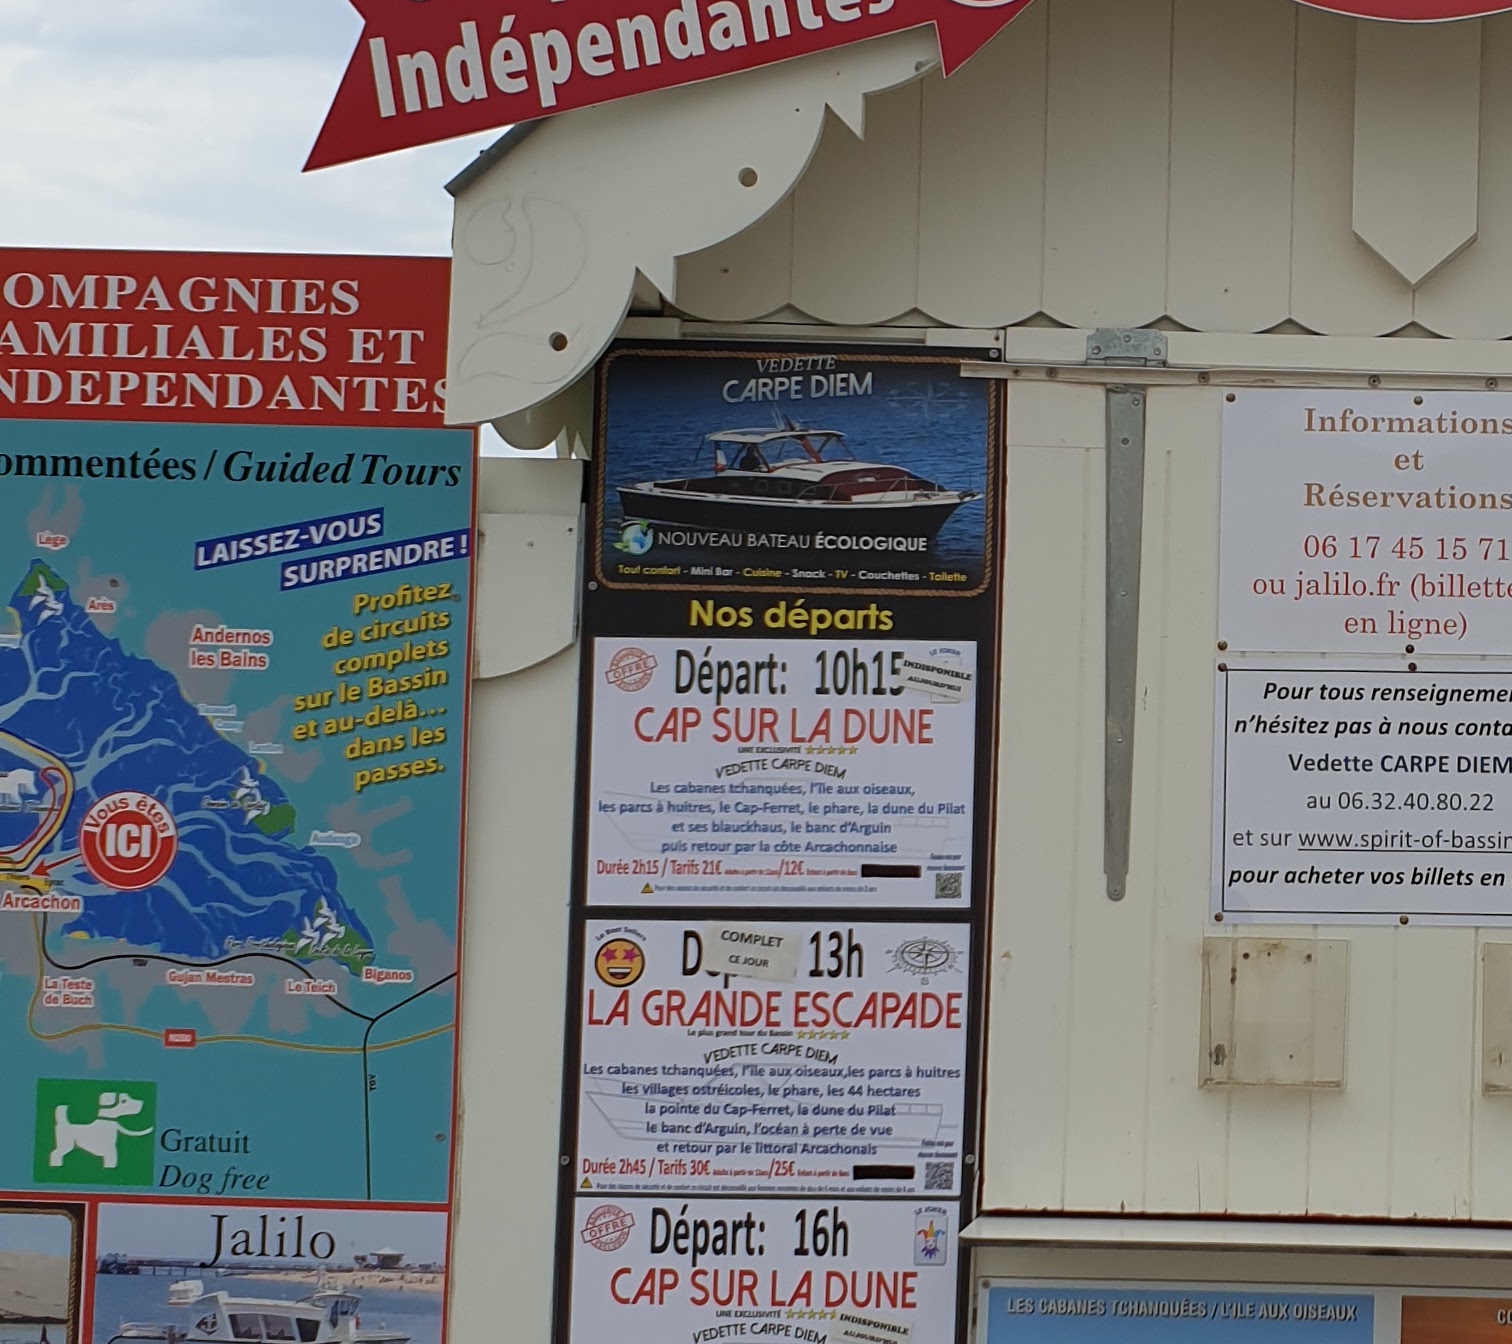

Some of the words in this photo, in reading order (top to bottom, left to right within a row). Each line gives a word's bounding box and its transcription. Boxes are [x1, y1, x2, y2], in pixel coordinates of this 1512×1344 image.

[4, 273, 360, 315] OMPAGNIES
[348, 329, 425, 365] ET
[757, 356, 837, 374] VEDETTE
[722, 375, 802, 403] CARPE
[811, 372, 873, 400] DIEM
[224, 451, 350, 484] Guided
[361, 455, 462, 486] Tours
[1394, 450, 1424, 471] et
[197, 514, 381, 567] LAISSEZ-VOUS
[658, 532, 742, 547] NOUVEAU
[747, 533, 810, 548] BATEAU
[815, 533, 927, 552] ÉCOLOGIQUE
[1304, 535, 1337, 558] 06
[1350, 535, 1380, 558] 17
[1391, 536, 1424, 559] 45
[1436, 537, 1467, 560] 15
[1478, 538, 1509, 561] 71
[283, 538, 454, 587] SURPRENDRE
[353, 580, 452, 616] Profitez
[1252, 576, 1286, 596] ou
[1294, 572, 1400, 601] jalilo.fr
[323, 626, 352, 649] de
[359, 610, 450, 645] circuits
[689, 600, 753, 628] Nos
[764, 599, 894, 635] départs
[1344, 614, 1377, 635] en
[1388, 611, 1467, 640] ligne)
[193, 628, 271, 645] Andernos
[190, 651, 213, 667] les
[218, 652, 267, 668] Bains
[334, 639, 449, 677] complets
[294, 690, 332, 711] sur
[338, 681, 361, 705] le
[368, 667, 447, 700] Bassin
[675, 646, 788, 705] Départ:
[815, 648, 906, 696] 10h15
[1264, 682, 1313, 703] Pour
[1319, 683, 1365, 703] tous
[293, 718, 317, 740] et
[634, 707, 701, 744] CAP
[712, 707, 778, 744] SUR
[791, 708, 832, 744] LA
[843, 709, 935, 744] DUNE
[345, 734, 405, 759] dans
[411, 725, 446, 751] les
[355, 757, 445, 792] passes.
[1289, 753, 1374, 773] Vedette
[1380, 754, 1450, 774] CARPE
[1456, 755, 1512, 775] DIEM
[1306, 793, 1331, 811] au
[1338, 791, 1494, 813] 06.32.40.80.22
[105, 824, 152, 858] ICI
[1233, 830, 1254, 848] et
[1259, 832, 1293, 849] sur
[3, 893, 80, 910] Arcachon
[721, 930, 784, 949] COMPLET
[809, 928, 863, 979] 13h
[364, 968, 412, 983] Biganos
[588, 989, 629, 1026] LA
[642, 990, 782, 1027] GRANDE
[793, 991, 962, 1029] ESCAPADE
[160, 1128, 250, 1155] Gratuit
[160, 1165, 212, 1194] Dog
[221, 1169, 270, 1193] free
[200, 1213, 336, 1268] Jalilo
